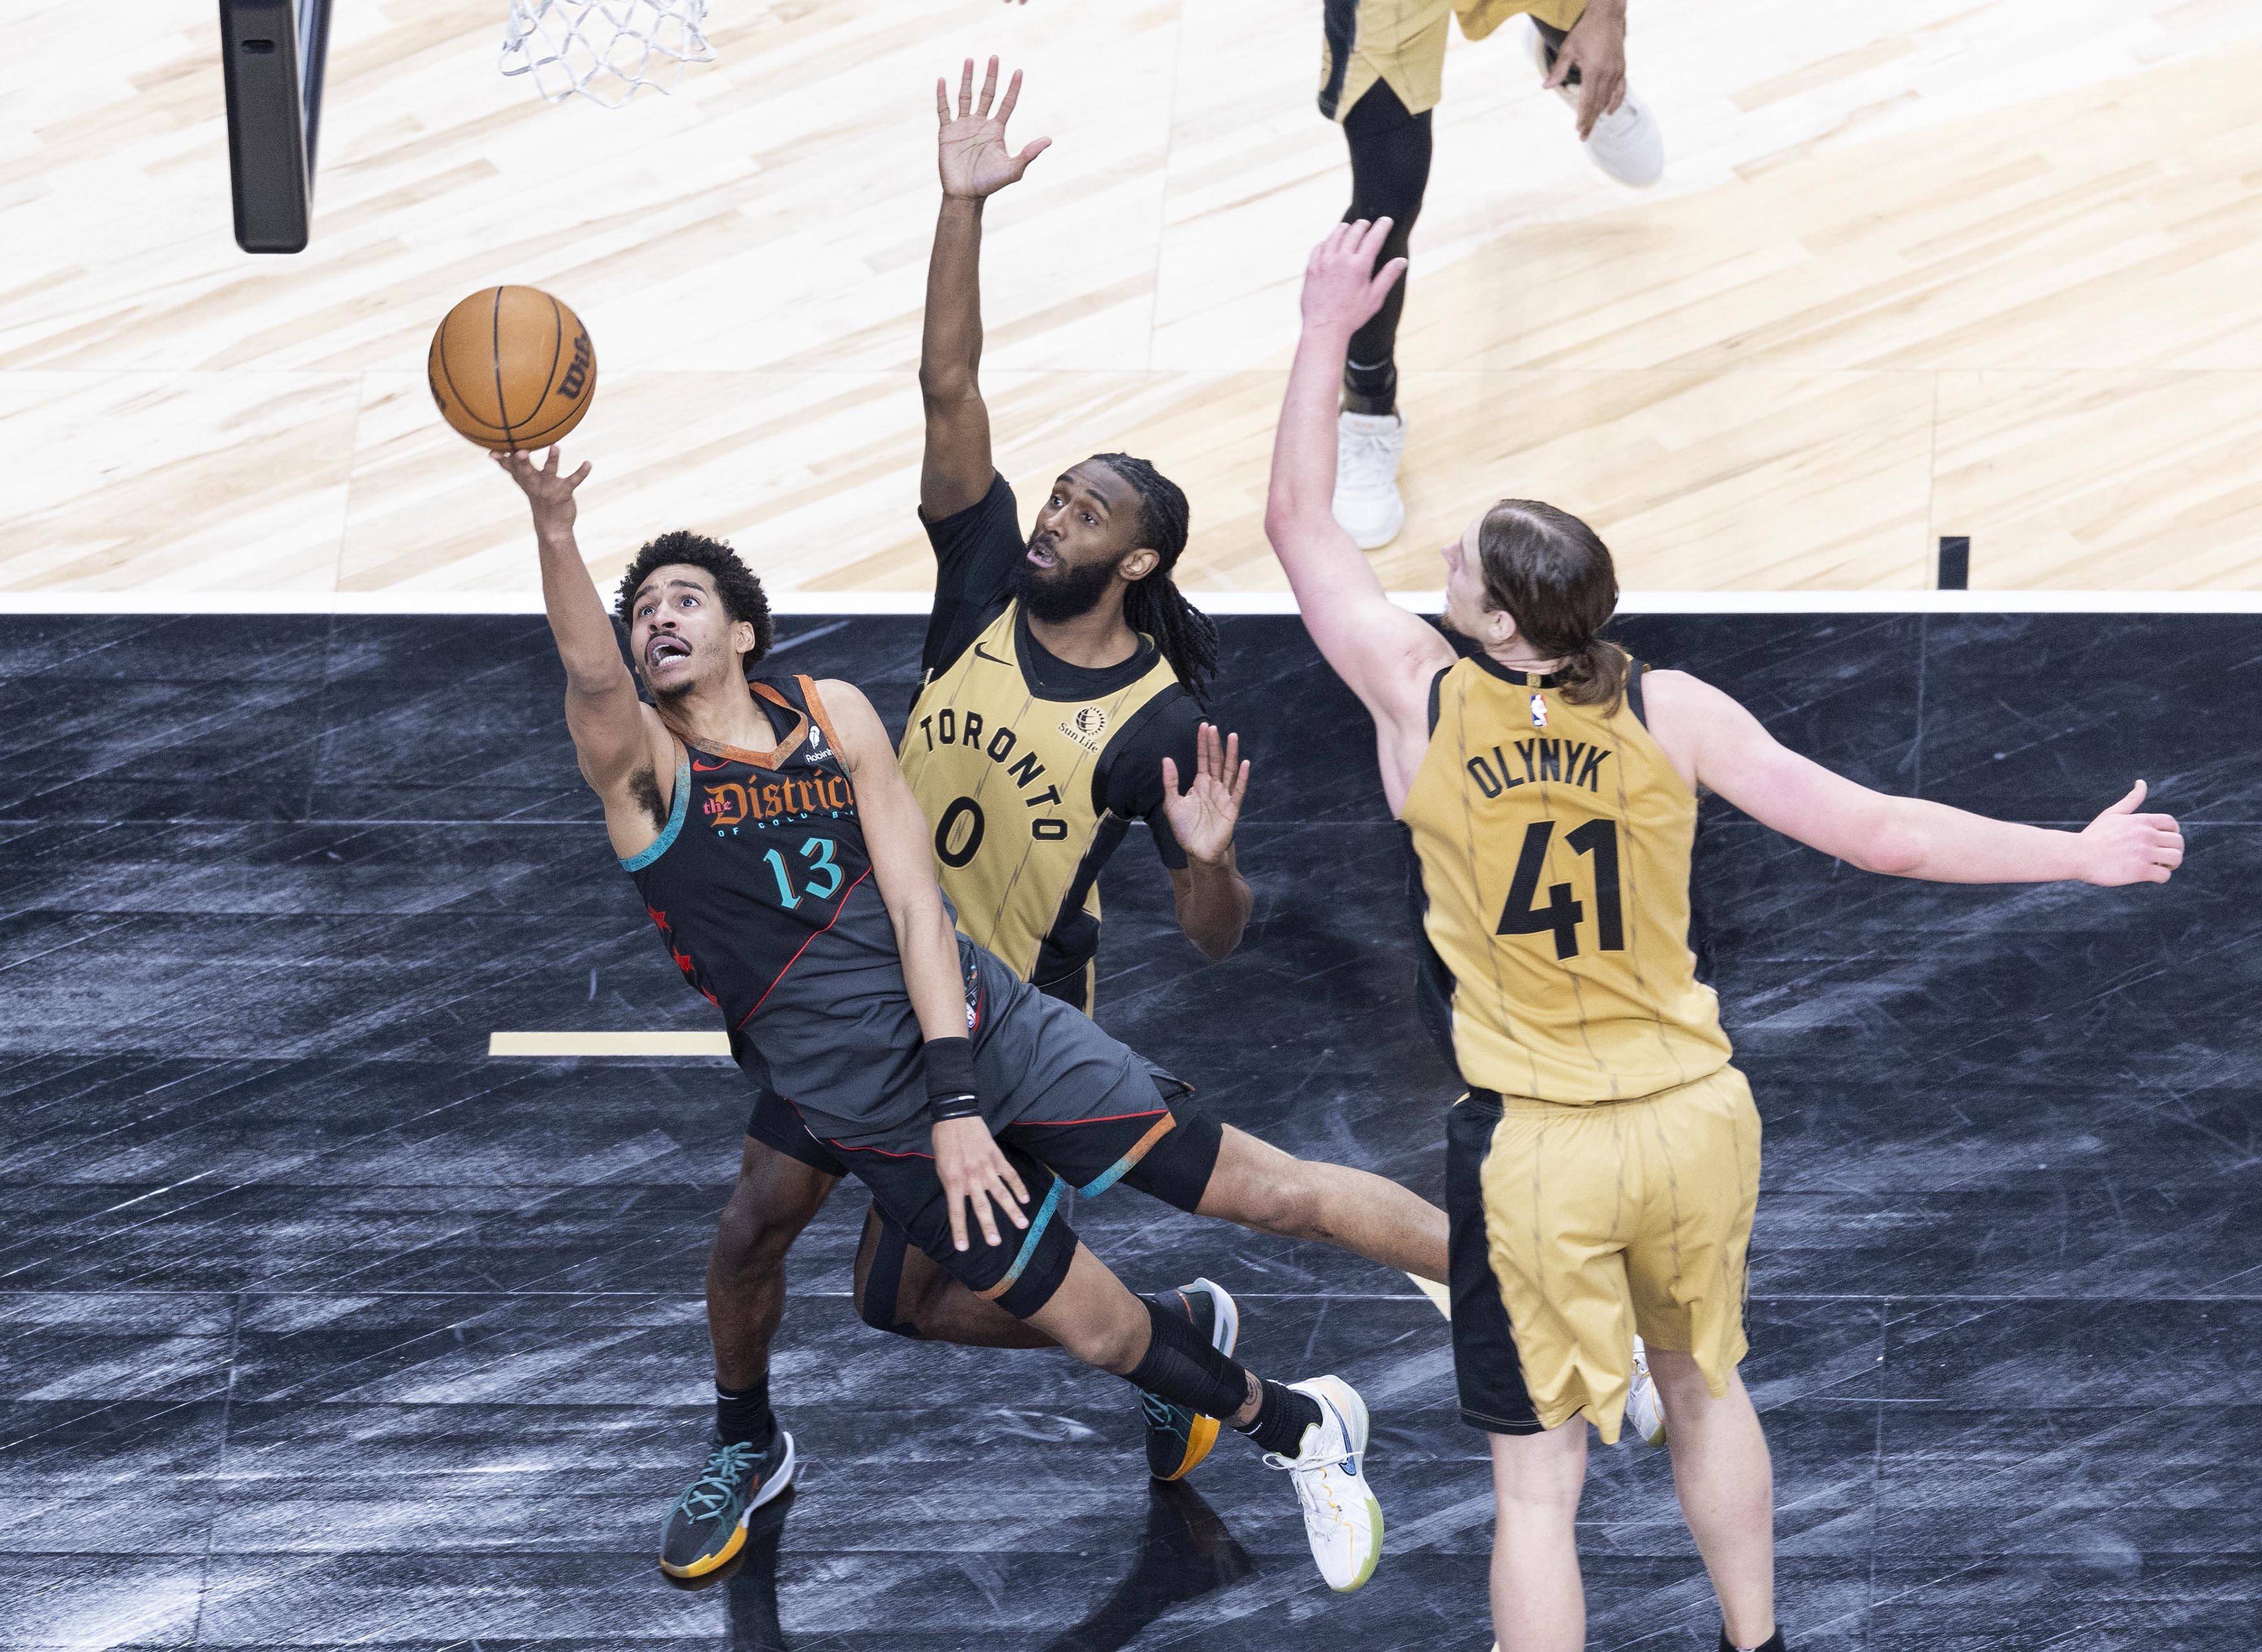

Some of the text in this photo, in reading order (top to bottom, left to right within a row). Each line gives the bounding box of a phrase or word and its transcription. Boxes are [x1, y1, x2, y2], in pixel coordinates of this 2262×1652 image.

[805, 748, 835, 763] Robinh
[1058, 722, 1098, 753] Sun Life
[1467, 737, 1613, 799] OLYNYK
[920, 708, 1068, 841] TORONTO
[702, 797, 733, 815] the
[718, 827, 739, 838] OF
[934, 796, 986, 868] 0
[762, 836, 845, 910] 13
[1496, 818, 1625, 961] 41
